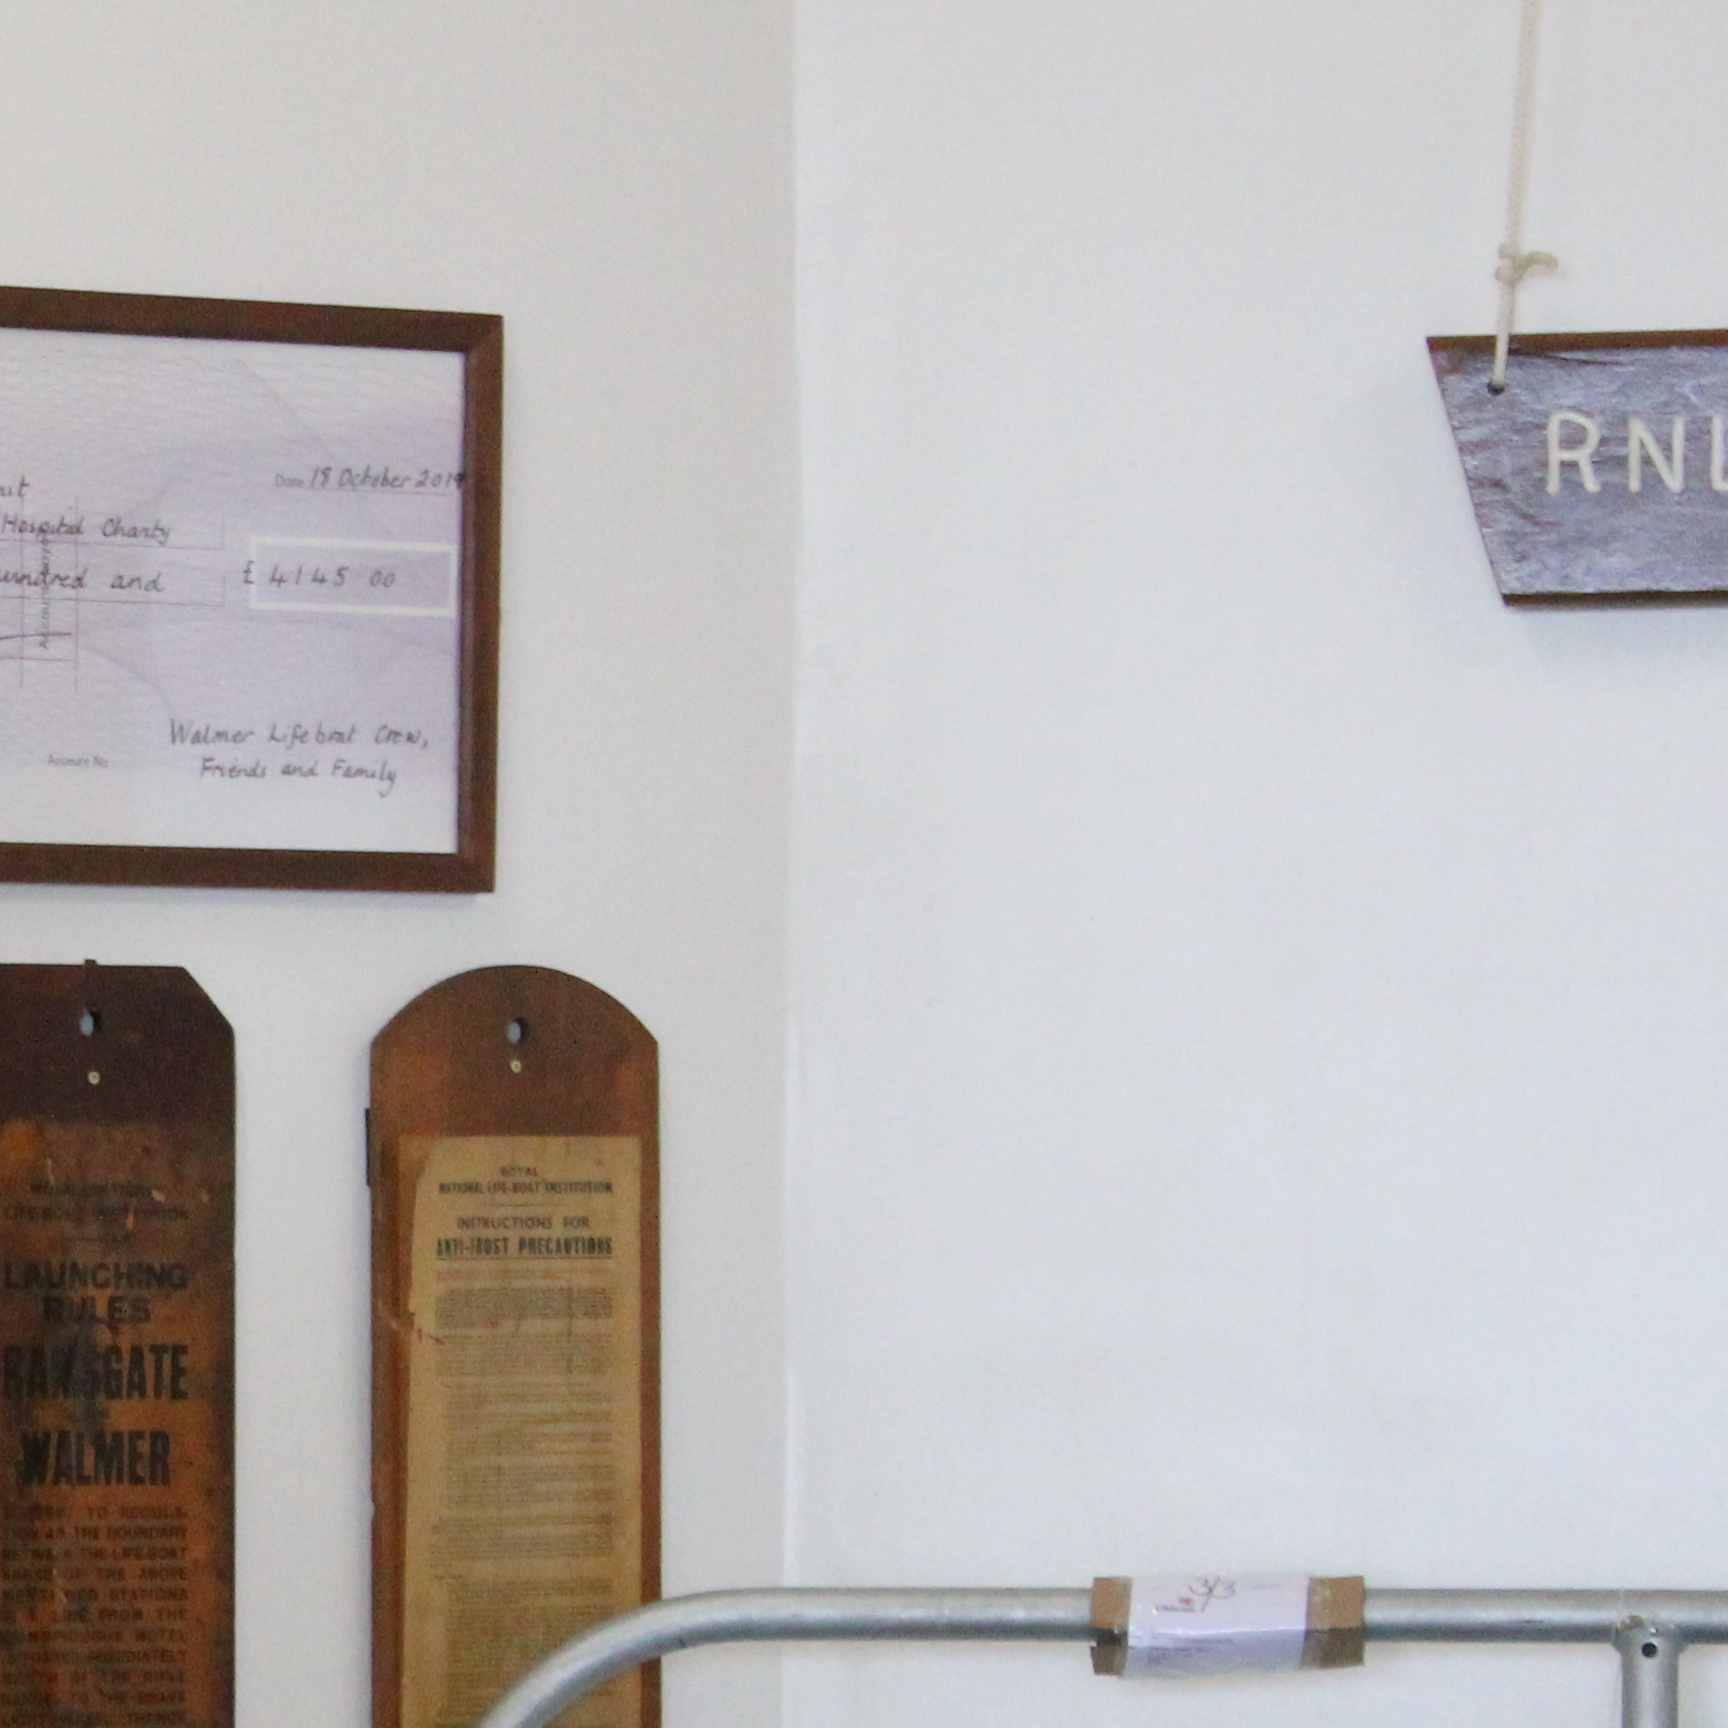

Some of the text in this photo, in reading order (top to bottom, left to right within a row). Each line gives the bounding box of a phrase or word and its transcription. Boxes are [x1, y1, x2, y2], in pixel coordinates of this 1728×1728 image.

[1545, 411, 1728, 493] RNL
[338, 465, 411, 488] October
[2, 514, 85, 540] Hospital
[110, 571, 165, 592] and
[170, 719, 255, 745] Walmer
[200, 757, 397, 798] Friends and Family
[457, 1216, 590, 1229] INSTRUCTIONS FOR
[519, 1236, 613, 1256] PRECAUTIONS
[3, 1261, 189, 1290] LAUNCHING
[44, 1295, 152, 1324] RULES
[15, 1428, 171, 1487] WALMER
